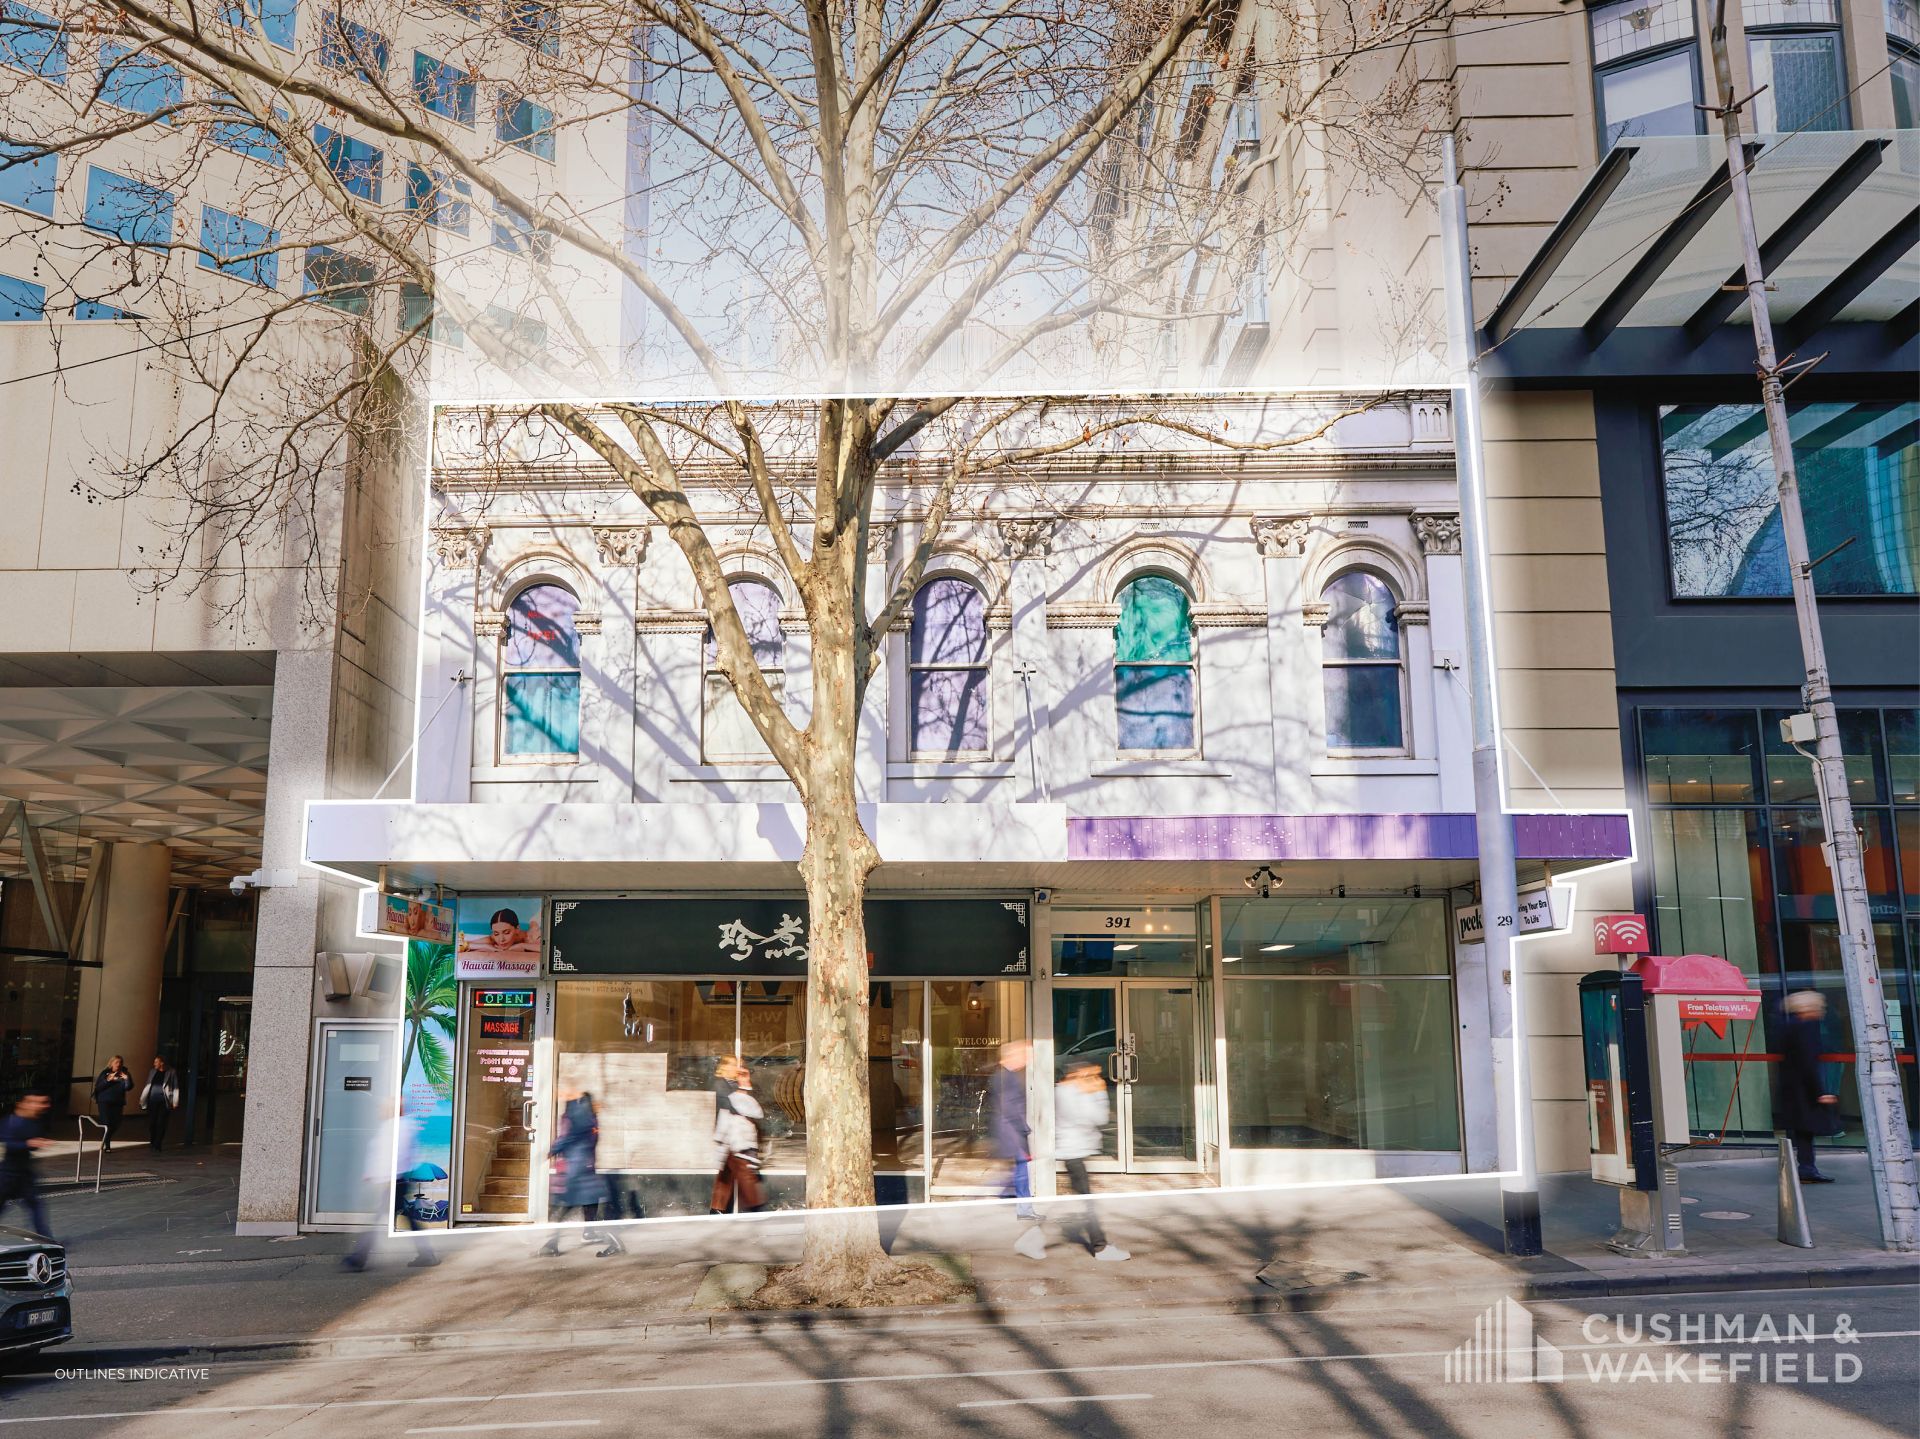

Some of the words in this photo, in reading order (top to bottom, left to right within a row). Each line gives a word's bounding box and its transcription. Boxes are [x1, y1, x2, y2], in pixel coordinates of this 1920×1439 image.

[1518, 904, 1528, 913] ring
[1528, 902, 1538, 911] Your
[1539, 900, 1547, 909] Bra
[387, 905, 405, 923] Hawaii
[1105, 916, 1131, 928] 391
[1460, 908, 1483, 939] peek
[1497, 915, 1513, 927] 29
[1524, 916, 1530, 925] To
[462, 961, 494, 971] Hawaii
[496, 961, 536, 973] Massage
[485, 994, 524, 1004] OPEN
[484, 1022, 519, 1034] MASSAGE
[957, 1037, 1001, 1046] WELCOME
